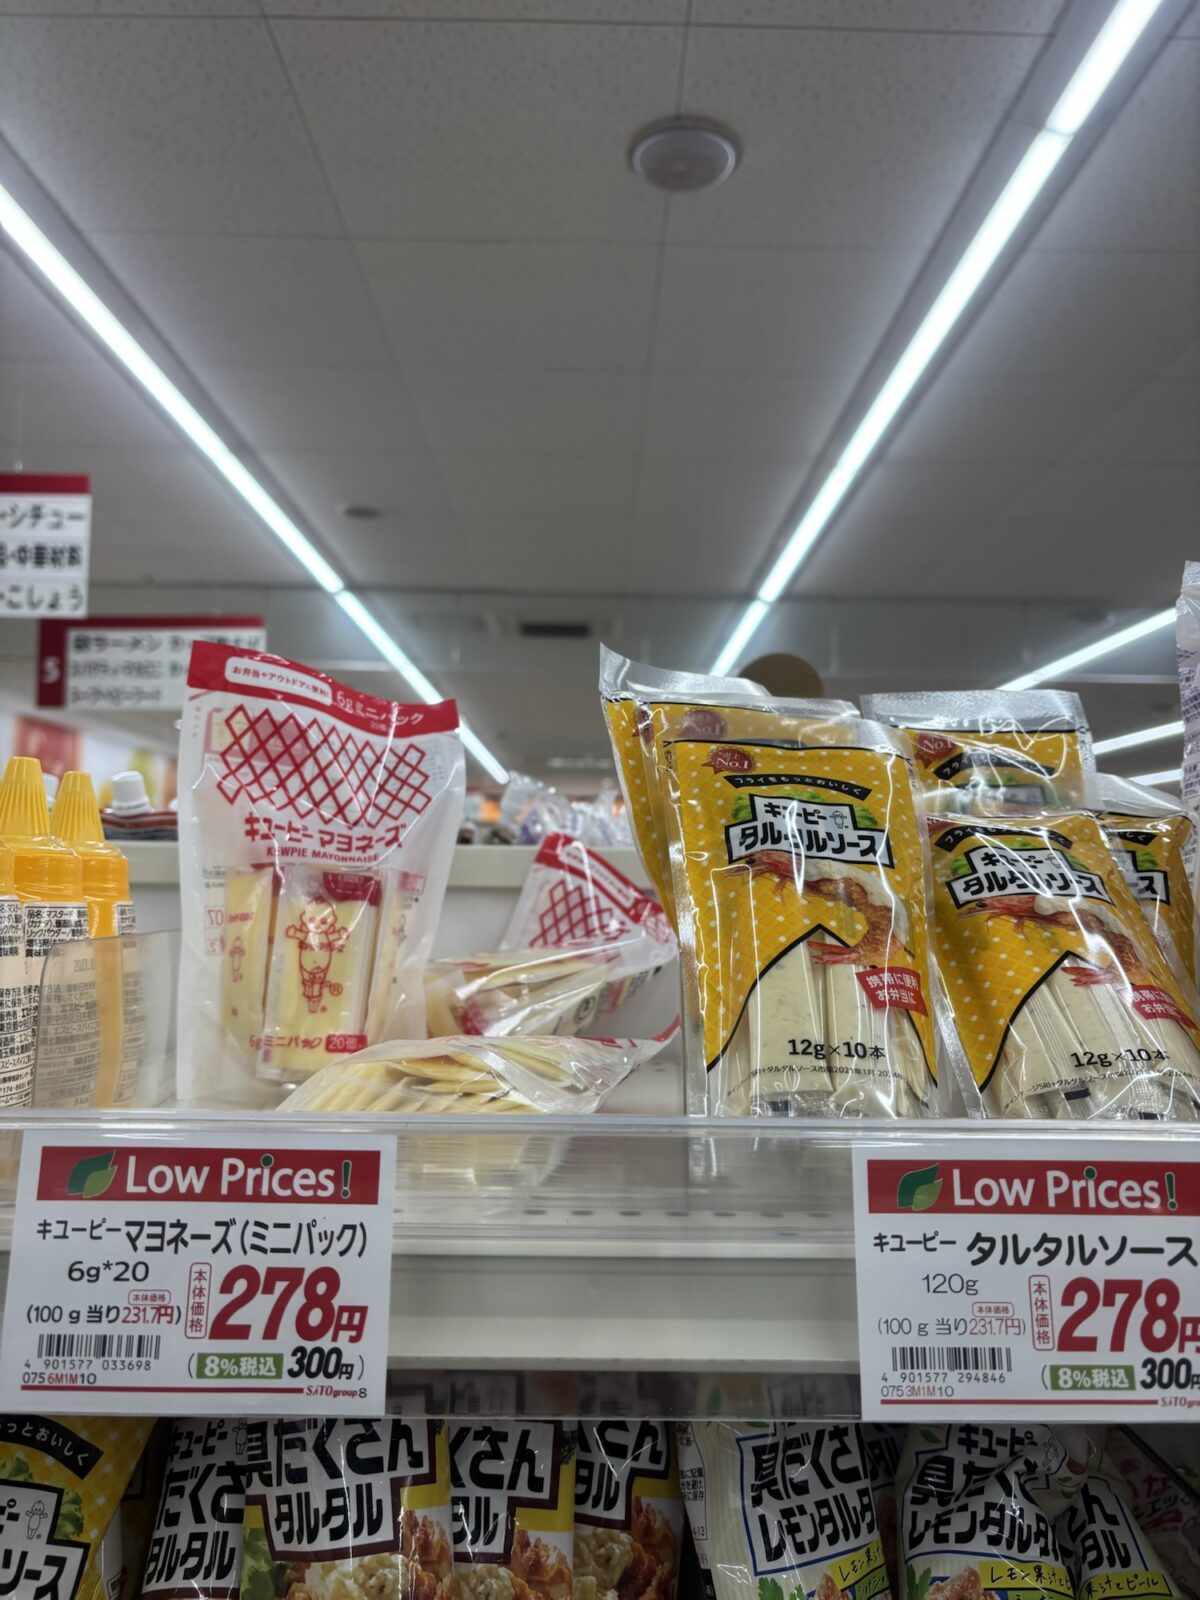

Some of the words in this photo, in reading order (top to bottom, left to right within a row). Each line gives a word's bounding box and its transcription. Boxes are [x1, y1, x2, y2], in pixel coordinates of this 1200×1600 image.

[716, 757, 749, 769] No.1
[734, 776, 863, 796] フライをもっとおいしく
[266, 846, 309, 859] KEWPIE
[311, 849, 380, 864] MAYONNAISE
[875, 988, 917, 1005] お弁当に
[126, 1155, 211, 1194] Low
[220, 1153, 353, 1200] Prices!
[952, 1168, 1036, 1207] Low
[1046, 1165, 1179, 1212] Prices!
[966, 1231, 1199, 1268] タルタルソース
[132, 1293, 167, 1303] 本体価格
[188, 1268, 208, 1334] 本体価格
[922, 1273, 979, 1296] 120g
[976, 1305, 1010, 1315] 本体価格
[1032, 1280, 1051, 1345] 本体価格
[0, 1421, 90, 1467] っとおいしく
[275, 1482, 384, 1545] タルタル
[145, 1530, 237, 1586] タルタル
